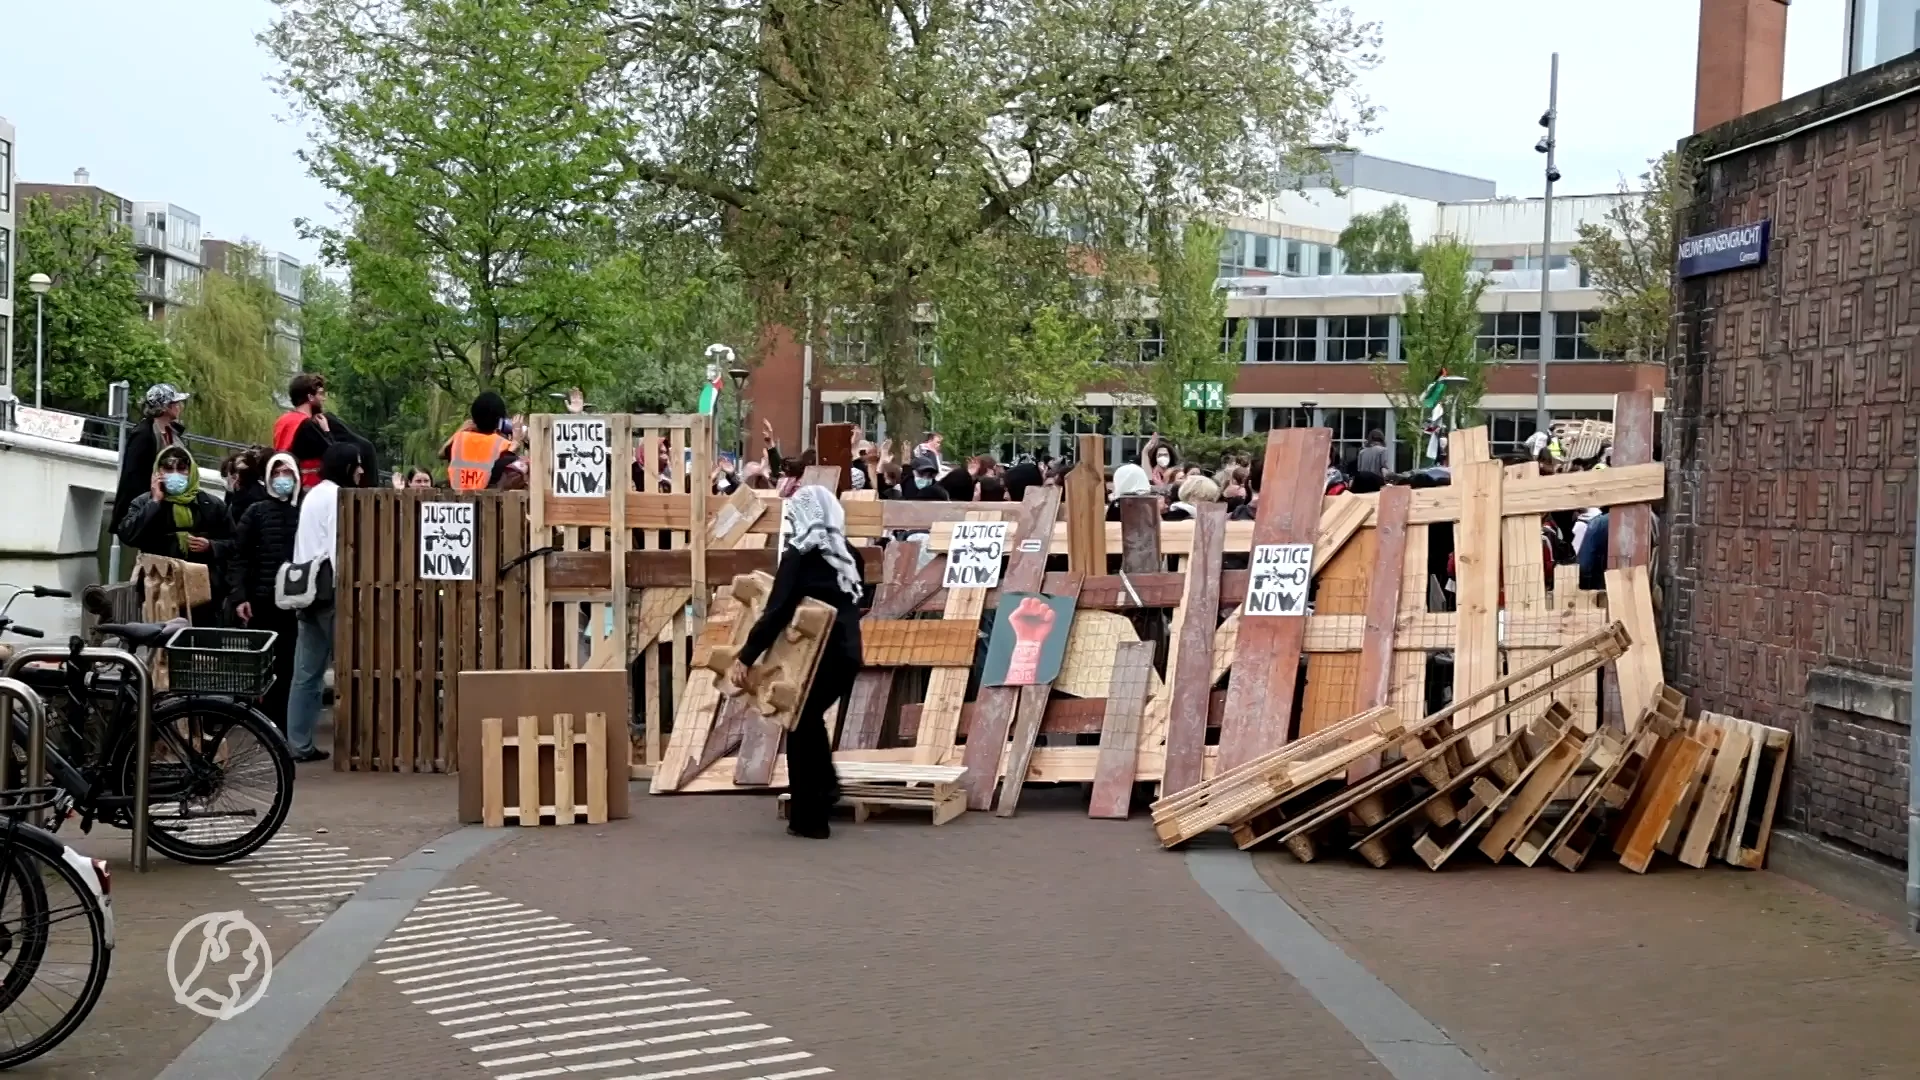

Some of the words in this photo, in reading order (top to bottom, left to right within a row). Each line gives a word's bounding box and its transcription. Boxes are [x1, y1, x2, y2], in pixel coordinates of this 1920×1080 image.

[1679, 239, 1703, 260] NIEUWE
[1703, 225, 1761, 254] PRINSENGRACHT
[556, 423, 604, 441] JUSTICE
[556, 471, 604, 493] NOW
[424, 505, 471, 524] JUSTICE
[954, 524, 1005, 539] JUSTICE
[424, 554, 470, 575] NOW
[1256, 547, 1310, 564] JUSTICE
[946, 565, 998, 584] NOW
[1248, 591, 1303, 612] NOW
